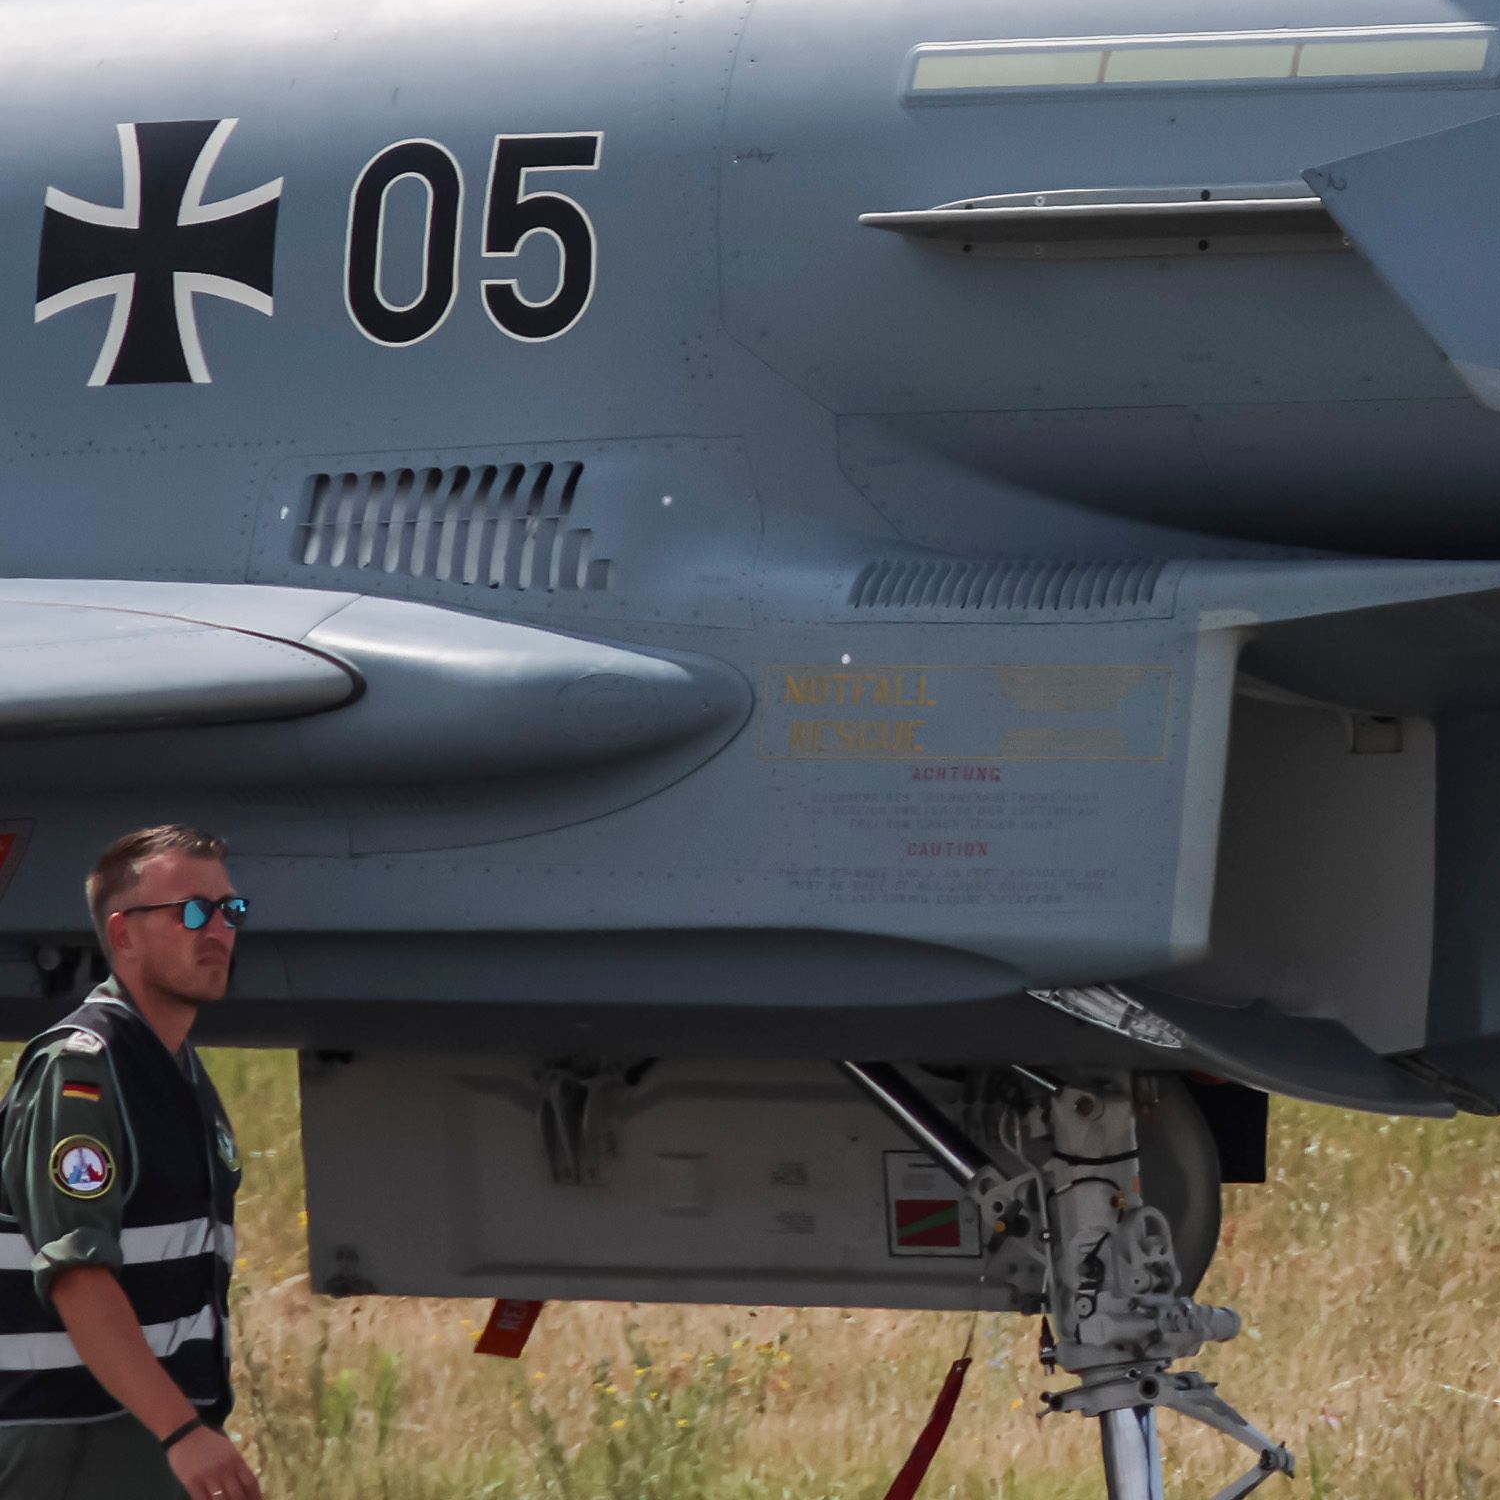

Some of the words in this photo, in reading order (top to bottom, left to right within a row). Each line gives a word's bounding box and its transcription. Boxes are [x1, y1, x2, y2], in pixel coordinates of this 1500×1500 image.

[344, 131, 604, 348] 05
[784, 673, 938, 707] NOTFALL
[789, 718, 926, 753] RESCUE
[912, 765, 1001, 782] ACHTUNG
[907, 841, 988, 857] CAUTION
